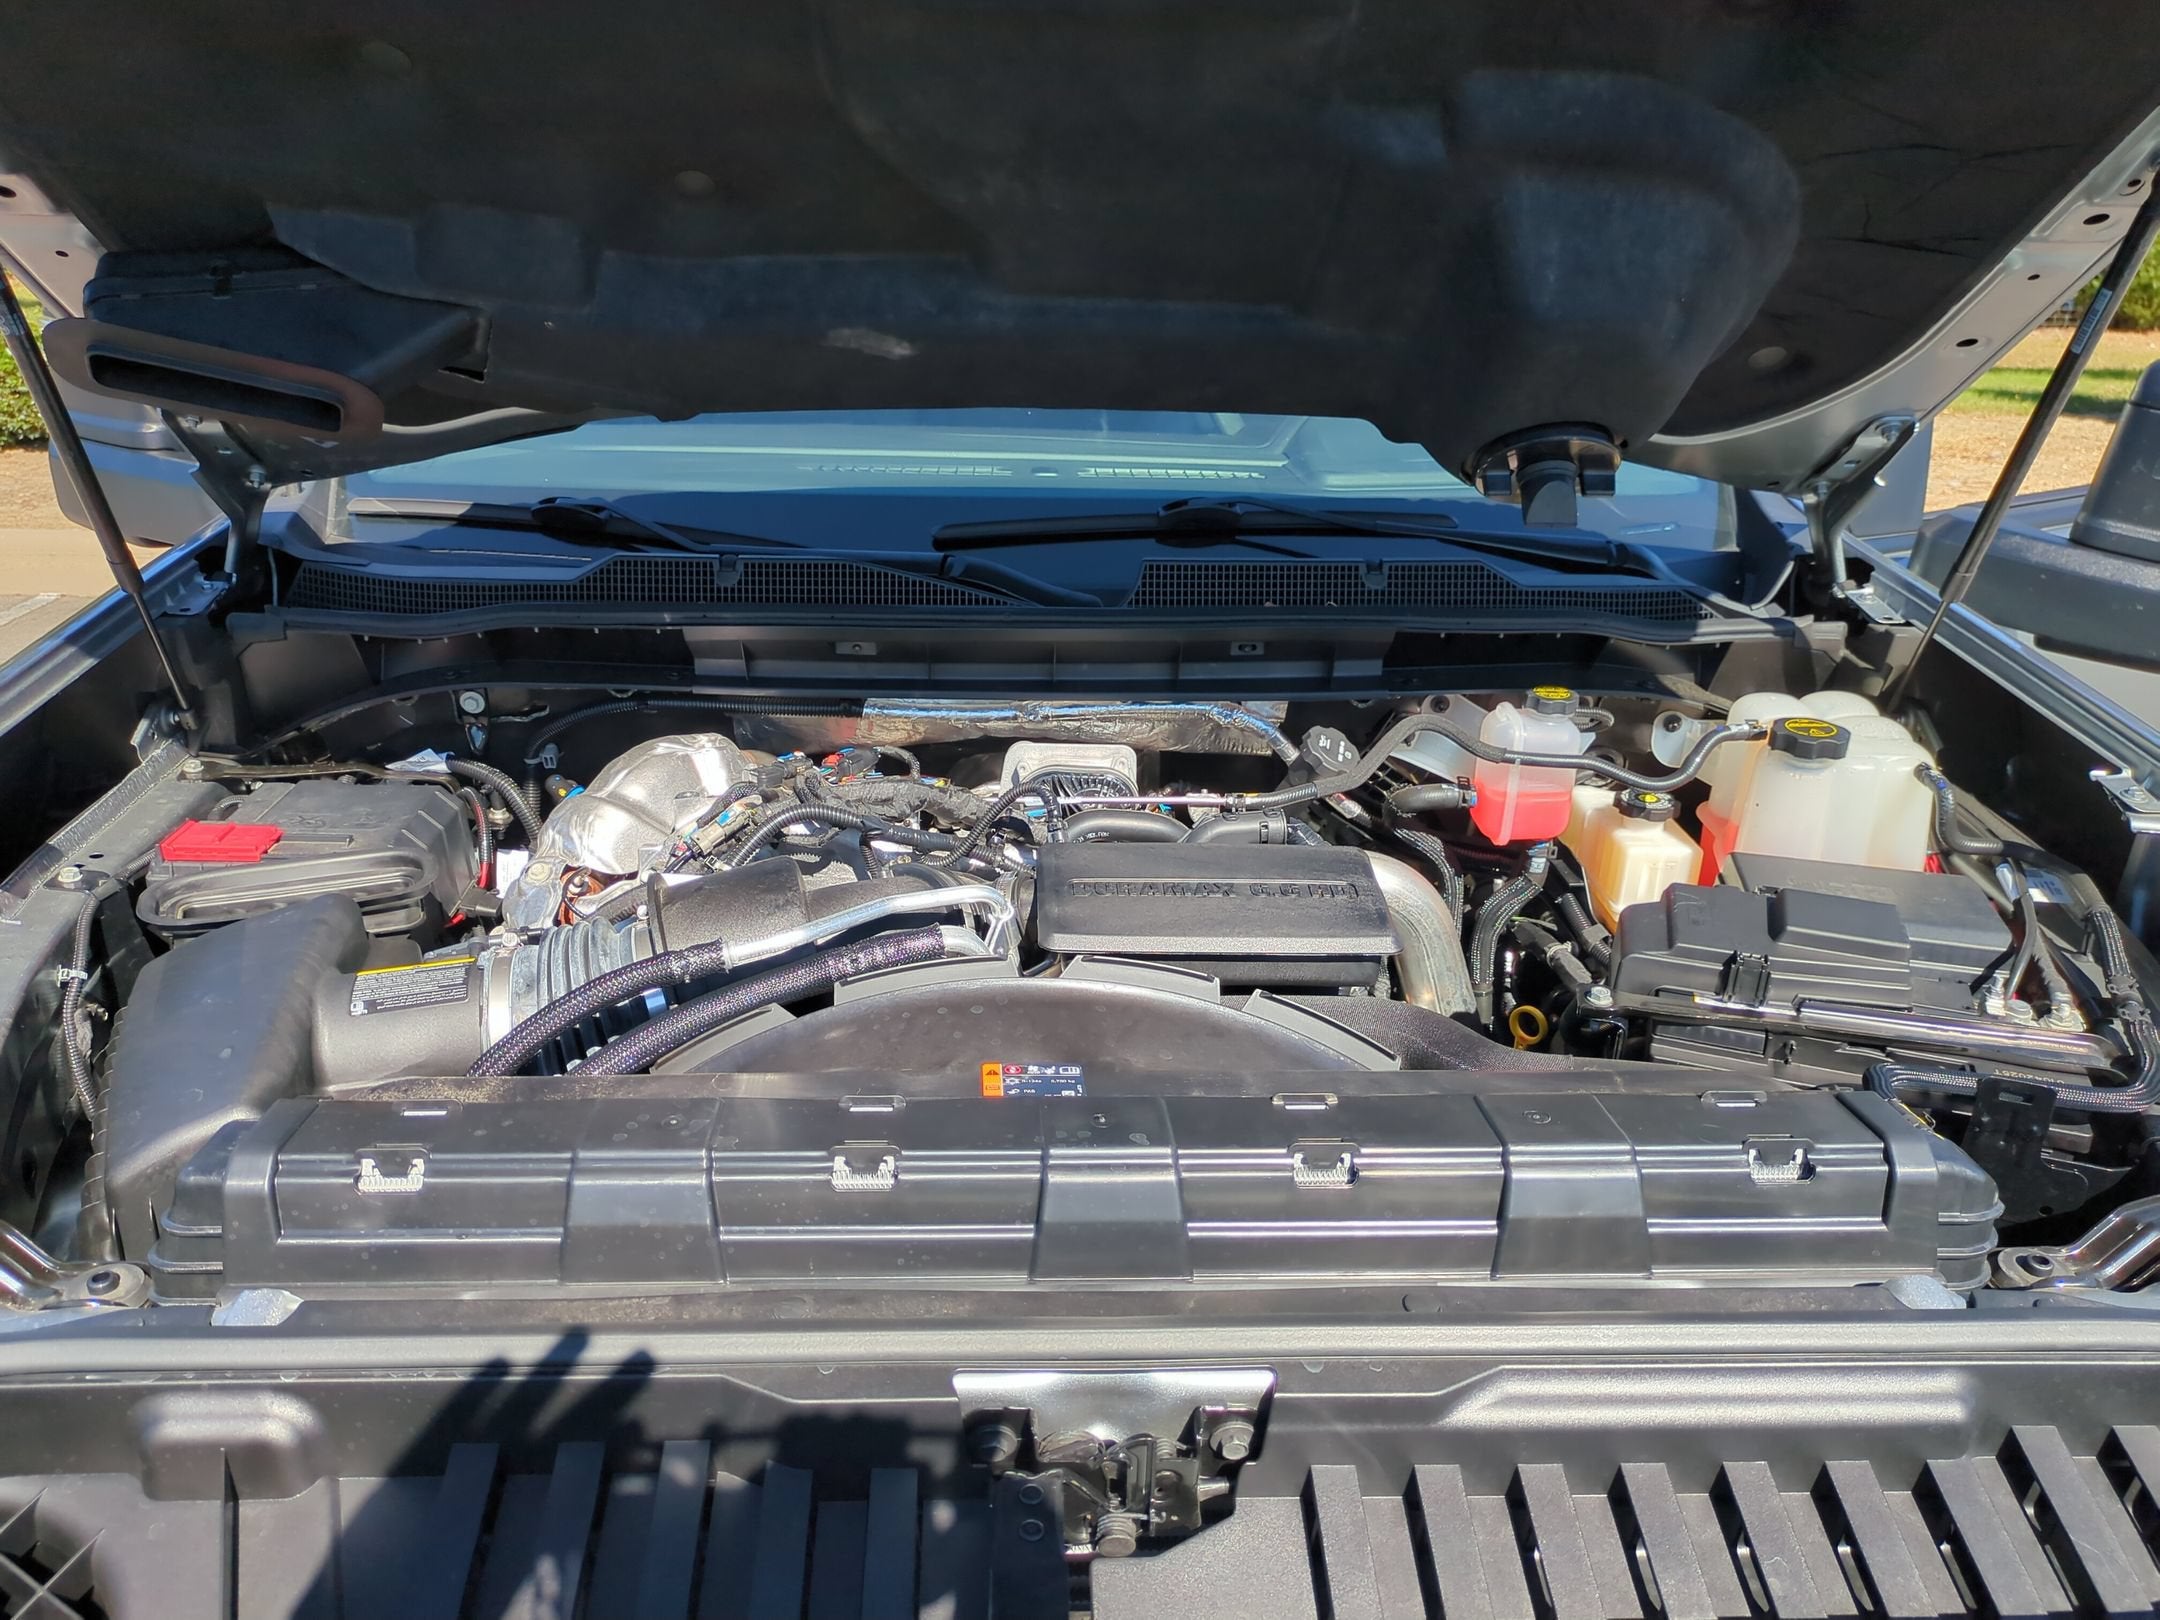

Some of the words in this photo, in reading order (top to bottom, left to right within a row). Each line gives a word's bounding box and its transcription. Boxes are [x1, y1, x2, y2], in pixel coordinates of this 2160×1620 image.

[1071, 881, 1236, 898] DURAMAX
[1249, 882, 1301, 898] 6.6
[1307, 883, 1359, 899] HD
